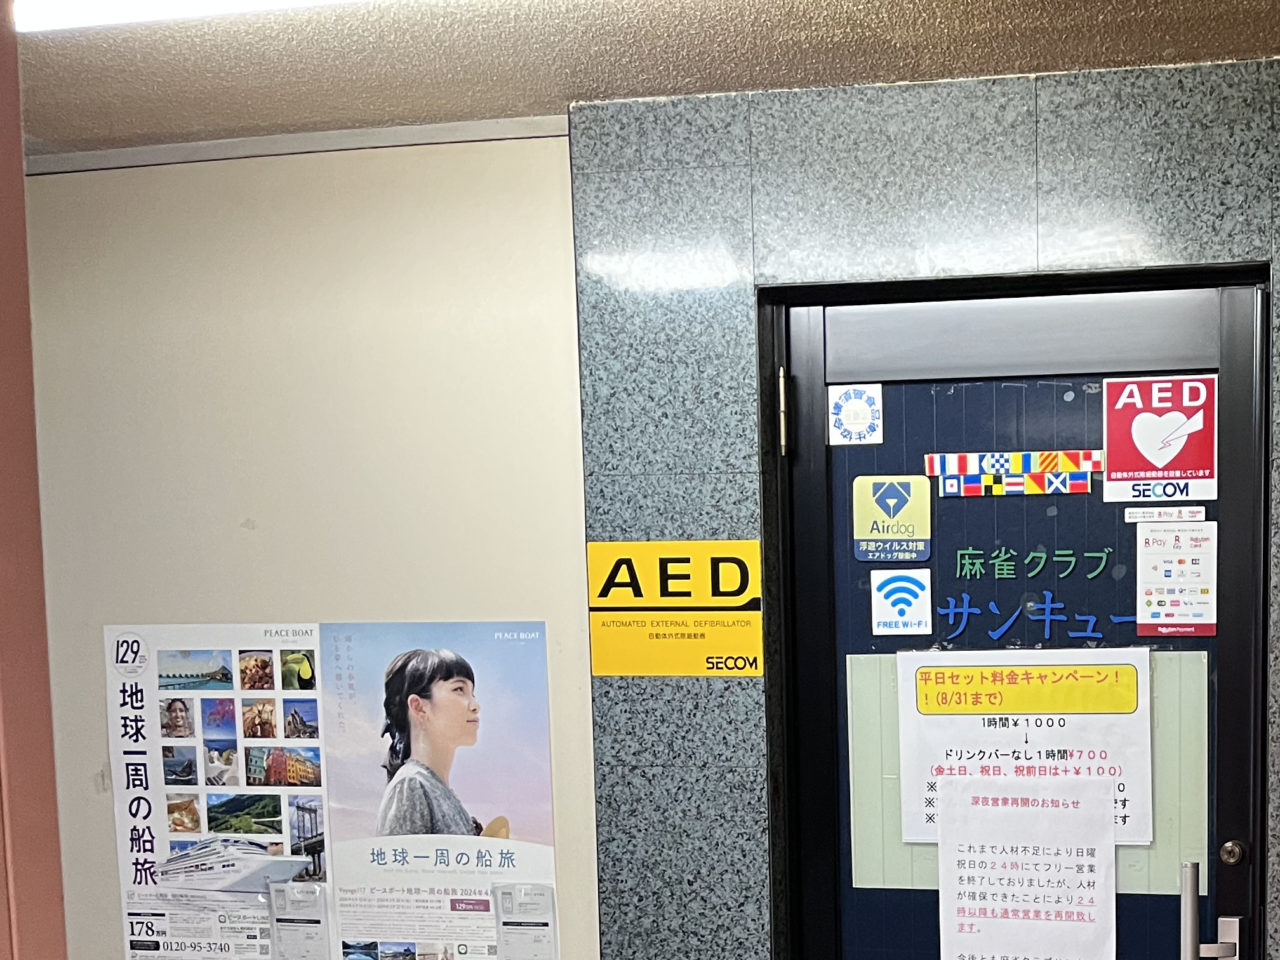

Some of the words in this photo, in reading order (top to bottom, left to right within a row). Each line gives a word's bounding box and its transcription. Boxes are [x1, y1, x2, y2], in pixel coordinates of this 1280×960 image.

[1115, 381, 1207, 409] AED
[1132, 482, 1189, 498] SECOM
[870, 520, 915, 537] Airdog
[956, 547, 1114, 579] 麻雀クラブ
[597, 557, 749, 598] AED
[937, 590, 1138, 640] サンキュー
[601, 620, 647, 628] AUTOMATED
[650, 620, 690, 628] EXTERNAL
[693, 620, 751, 628] DEFIBRILLATOR
[877, 621, 900, 629] FREE
[264, 629, 290, 638] PEACE
[292, 629, 314, 638] BOAT
[115, 640, 140, 664] 129
[706, 656, 758, 670] SECOM
[120, 681, 158, 887] 地球一周の船旅
[971, 796, 1081, 809] 深夜営業再開のお知らせ
[370, 848, 517, 869] 地球一周の船旅
[162, 941, 230, 953] 0120-95-3740
